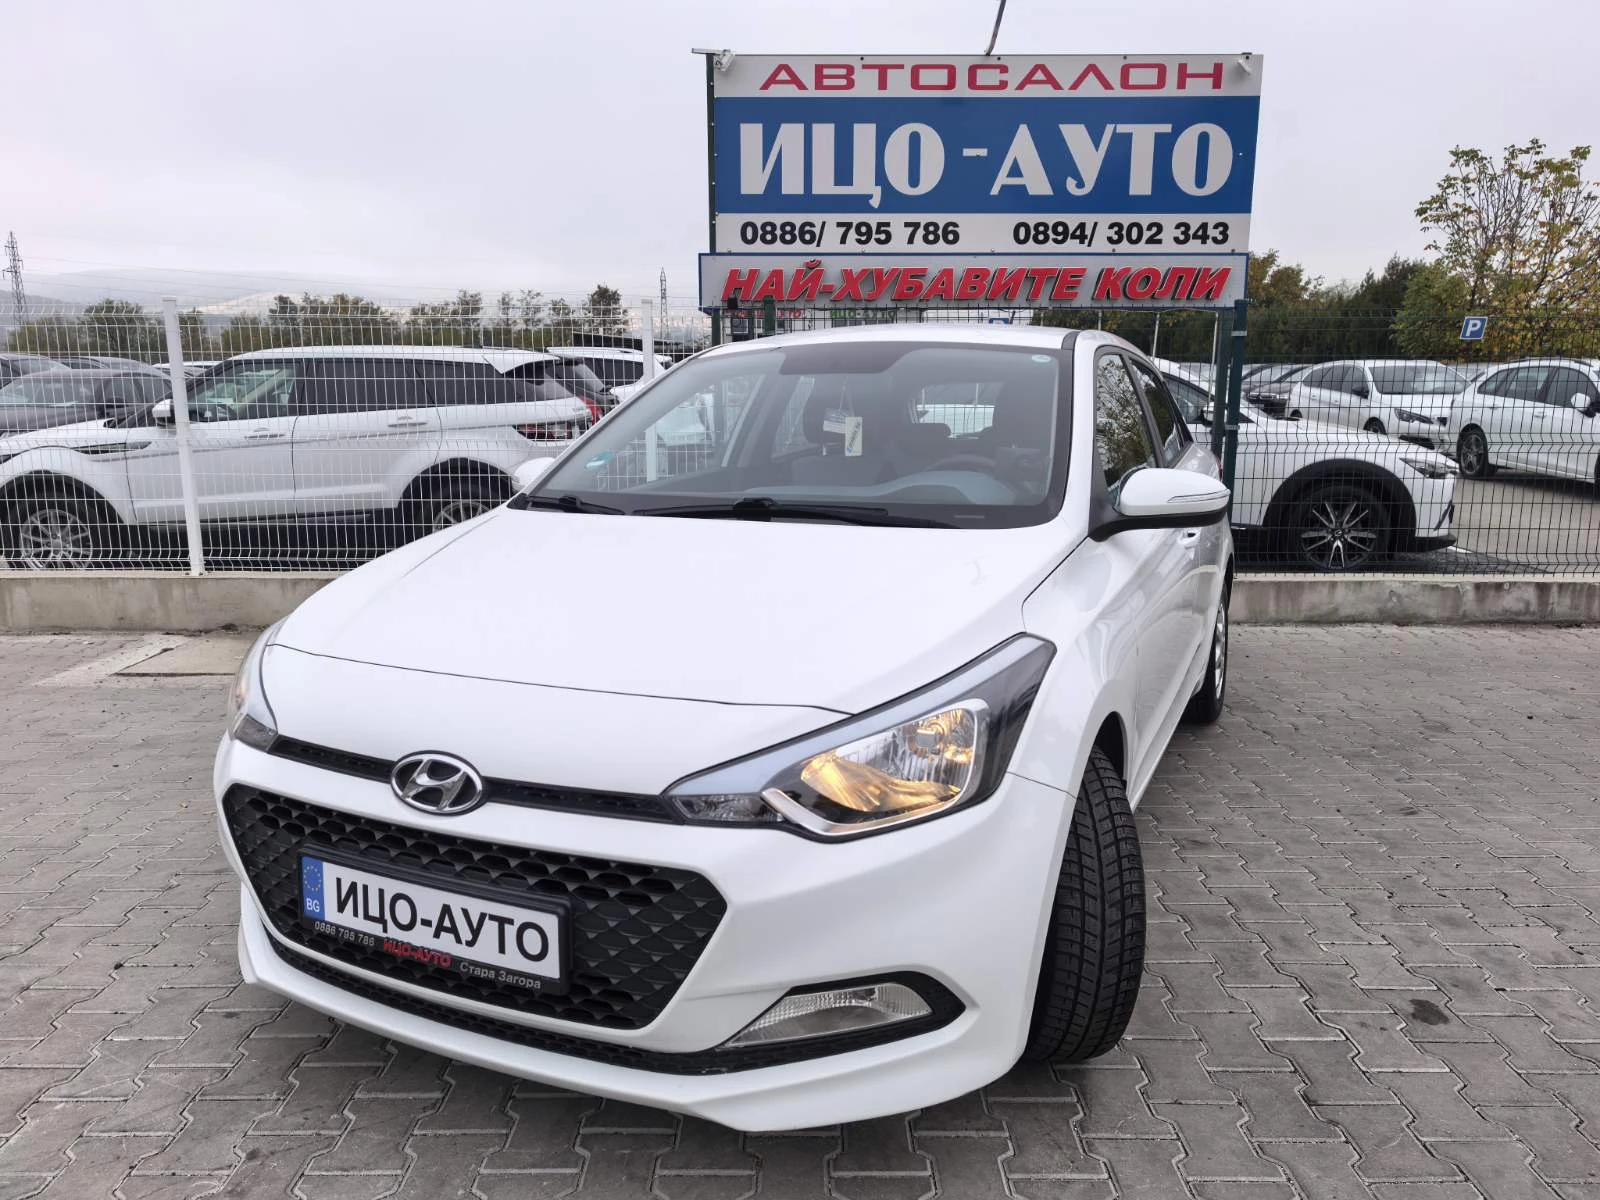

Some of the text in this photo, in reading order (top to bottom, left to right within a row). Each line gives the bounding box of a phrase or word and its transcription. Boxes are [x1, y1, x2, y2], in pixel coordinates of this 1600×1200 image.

[759, 63, 1223, 91] АВТОСАЛОН
[740, 221, 960, 248] 0886/ 795 786
[1013, 221, 1230, 247] 0894/ 302 343
[720, 259, 1232, 302] НАЙ-ХУБАВИТЕ КОЛИ
[1465, 319, 1482, 337] P
[306, 897, 320, 913] BG
[335, 877, 550, 962] ИЦО-АУТО
[314, 921, 375, 947] 0886 795 786
[383, 937, 452, 968] ИЦО-АУТО
[460, 961, 542, 990] Стара Загора
